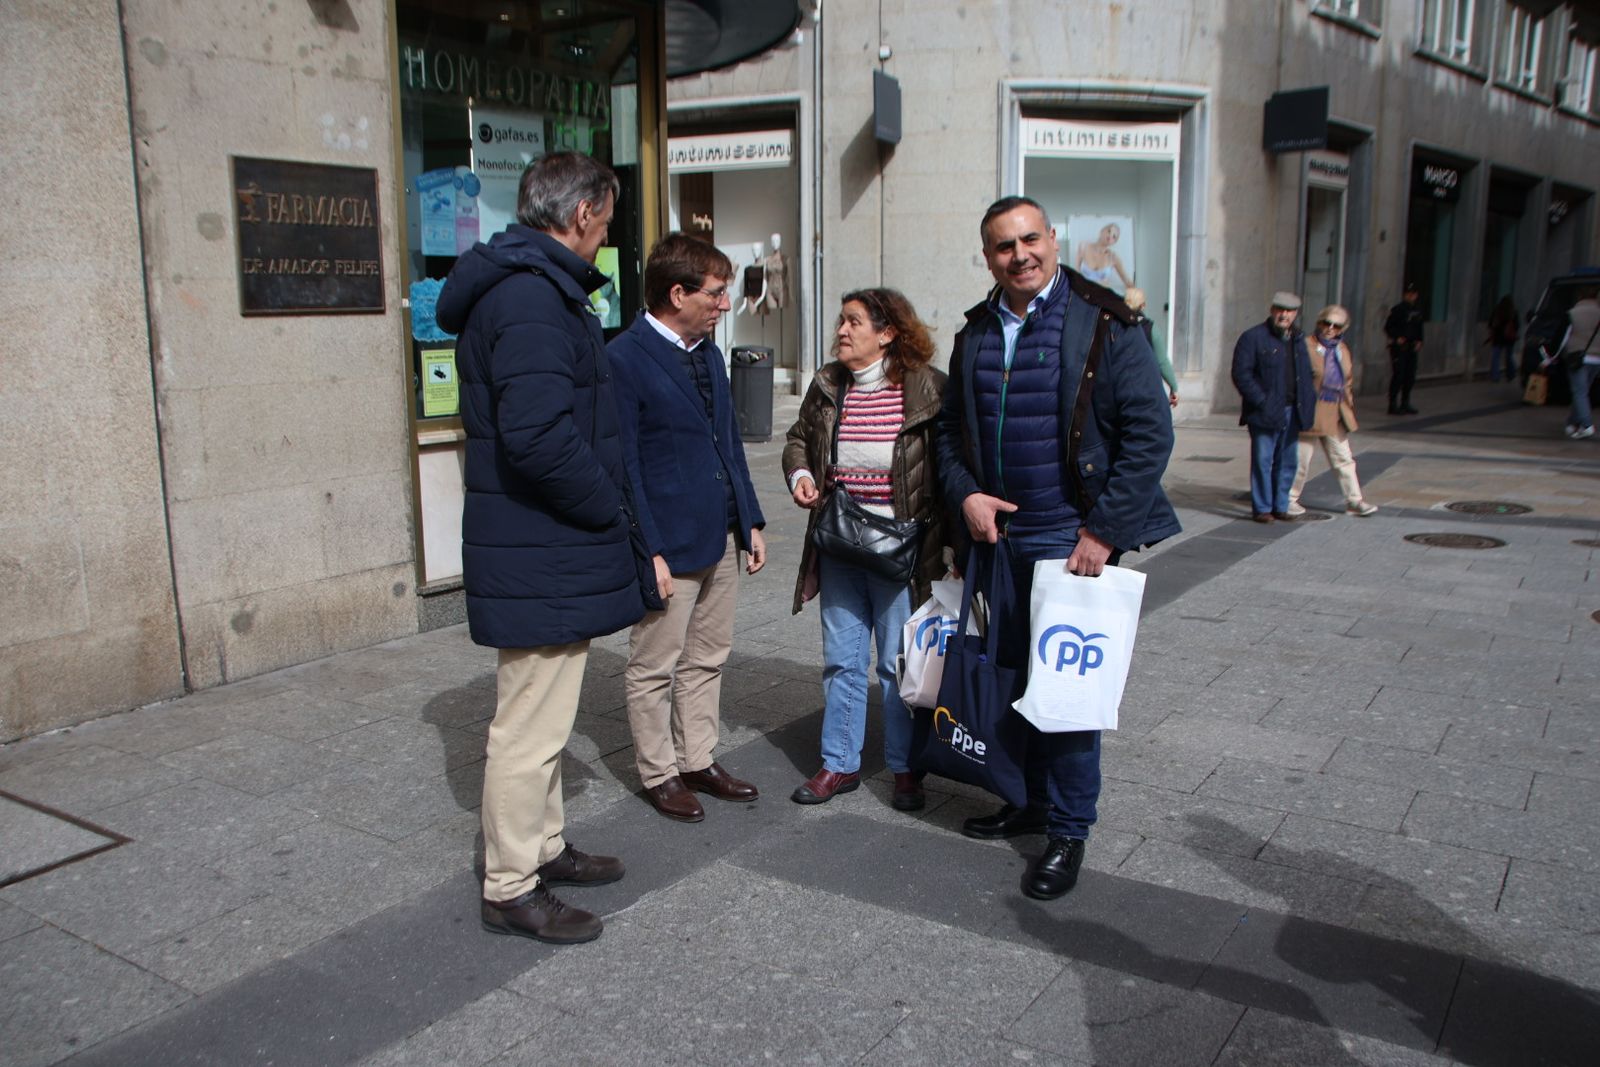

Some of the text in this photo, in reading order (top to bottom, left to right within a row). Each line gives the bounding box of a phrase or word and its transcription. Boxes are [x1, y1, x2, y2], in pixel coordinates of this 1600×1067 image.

[494, 127, 539, 144] gafas.es
[1034, 128, 1169, 149] intimissimi
[265, 192, 373, 227] FARMACIA
[268, 258, 329, 275] AMADOR
[334, 259, 380, 276] FELIPE
[951, 726, 987, 756] ppe
